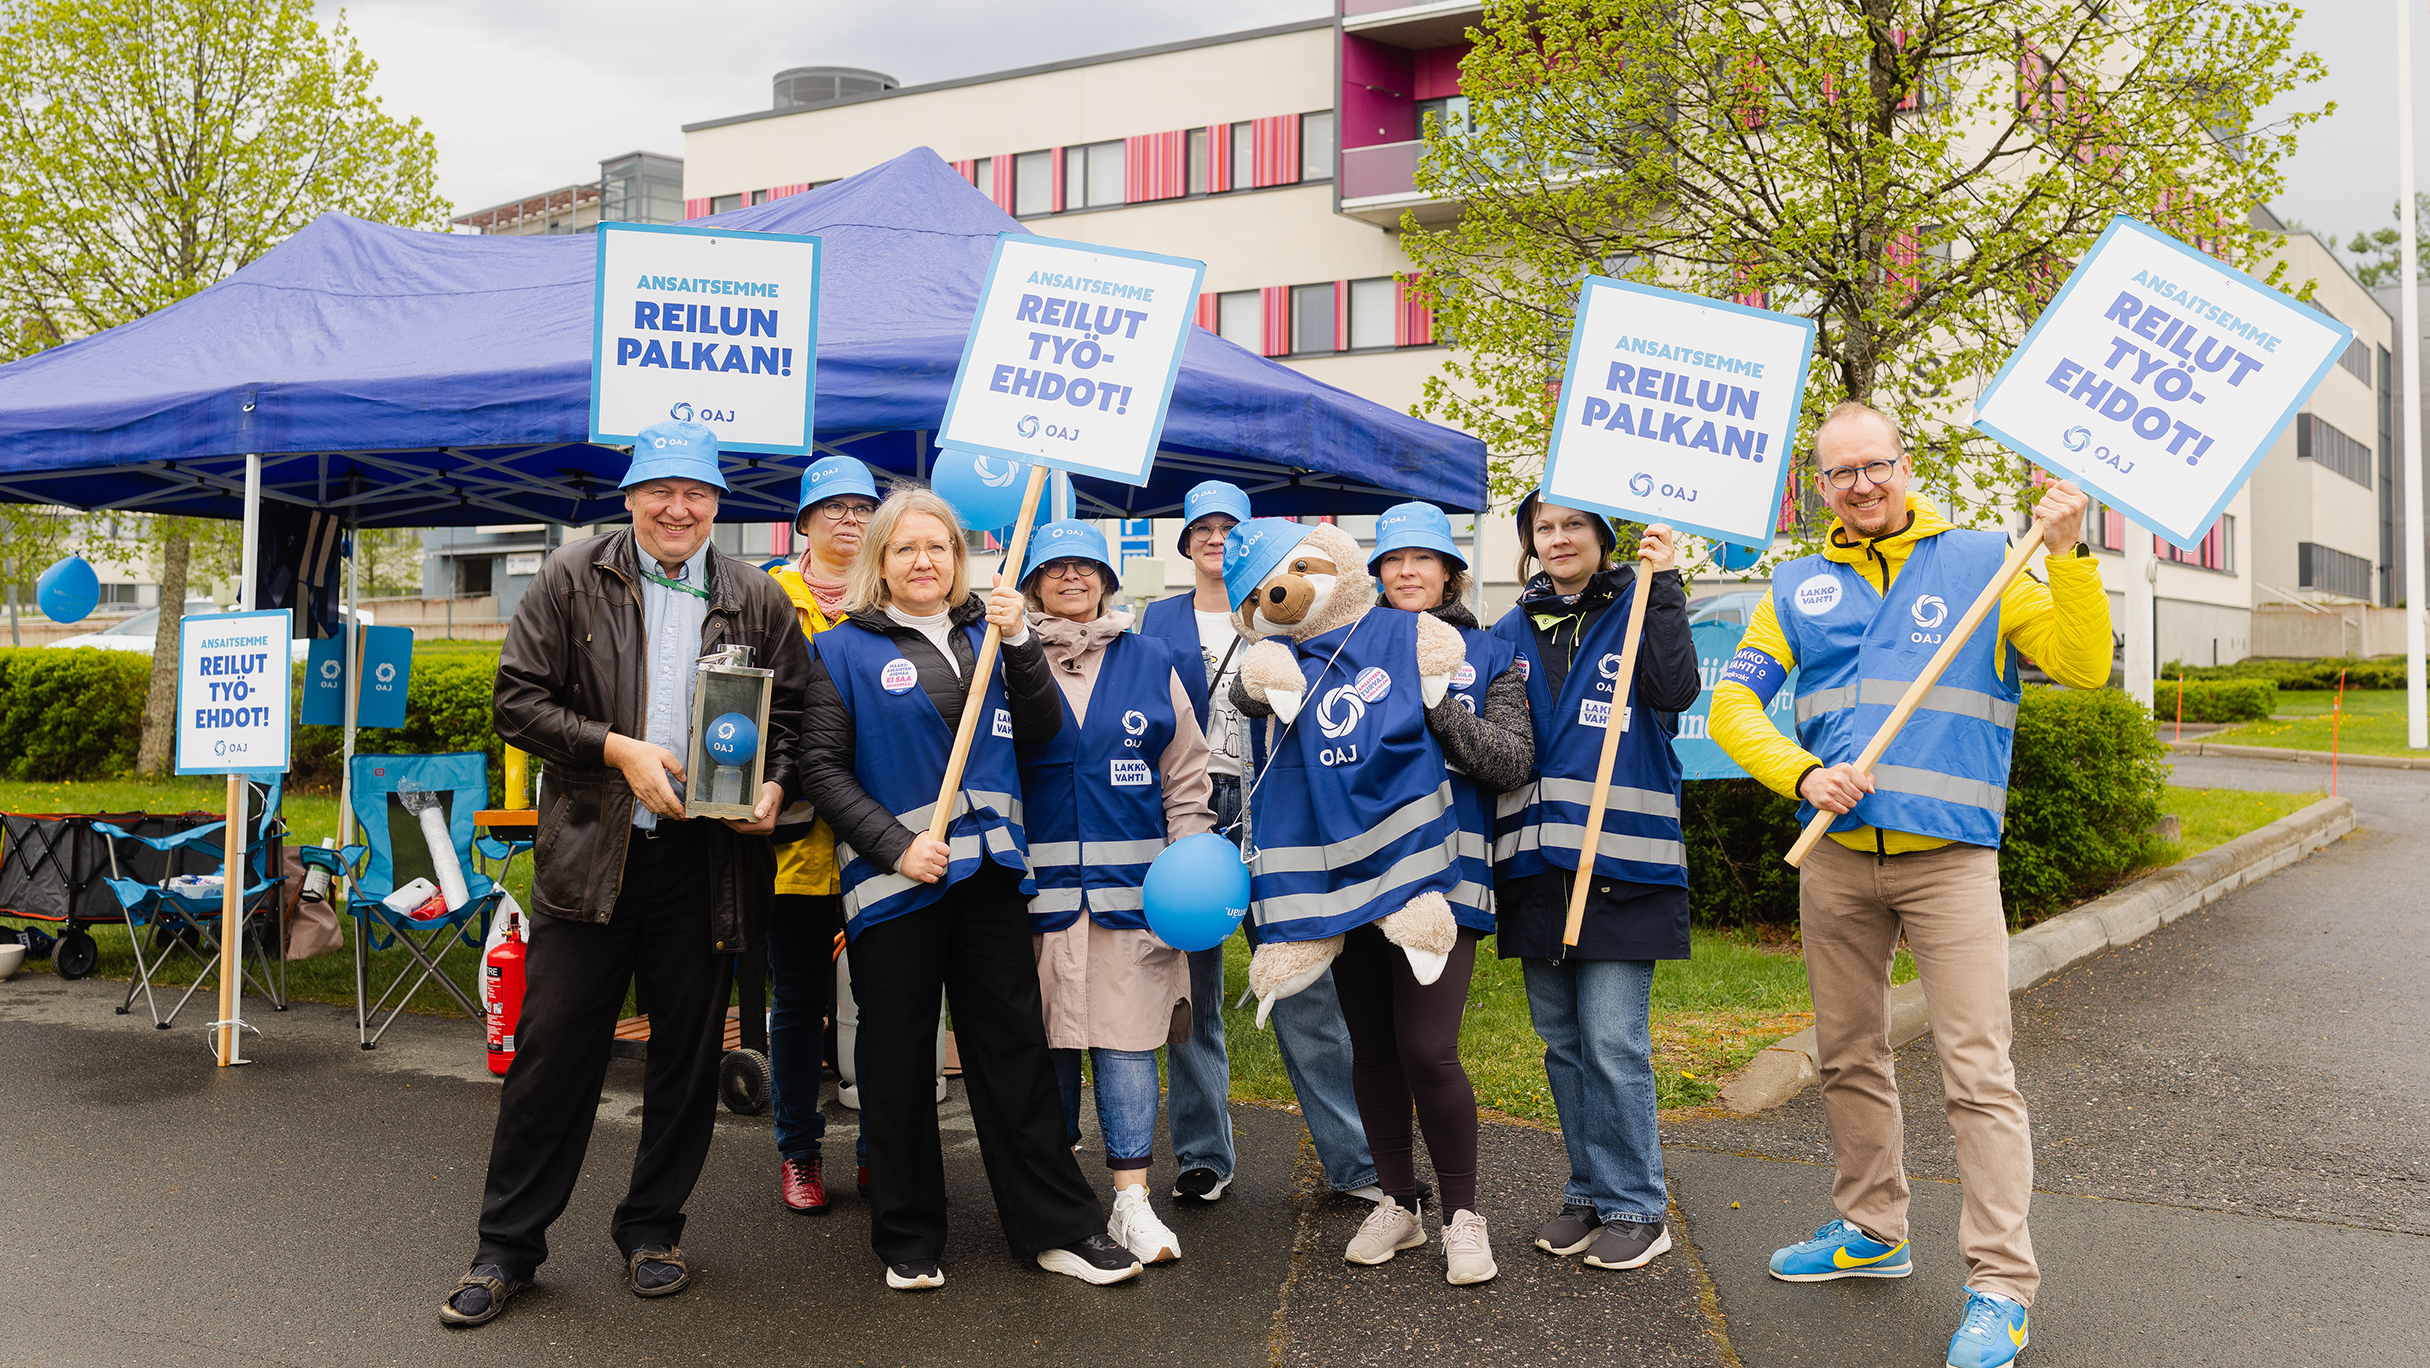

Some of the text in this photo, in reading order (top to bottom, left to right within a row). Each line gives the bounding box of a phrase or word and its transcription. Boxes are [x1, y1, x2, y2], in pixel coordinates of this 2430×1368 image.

[637, 275, 779, 298] ANSAITSEMME
[1026, 271, 1155, 303] ANSAITSEMME
[634, 300, 778, 338] REILUN
[1016, 293, 1148, 340] REILUT
[2131, 269, 2282, 354] ANSAITSEMME
[2104, 290, 2264, 387] REILUT
[617, 337, 793, 377] PALKAN!
[1029, 332, 1115, 370] TYÖ-
[1615, 335, 1765, 379] ANSAITSEMME
[2104, 336, 2206, 405] TYÖ-
[989, 363, 1133, 415] EHDOT!
[1606, 361, 1760, 421] REILUN
[700, 409, 735, 423] OAJ
[2045, 357, 2215, 466] EHDOT!
[1045, 424, 1080, 442] OAJ
[1581, 396, 1769, 463] PALKAN!
[669, 438, 688, 446] OAJ
[822, 467, 839, 476] OAJ
[2094, 446, 2135, 475] OAJ
[1200, 489, 1217, 497] OAJ
[1661, 484, 1698, 503] OAJ
[1390, 515, 1406, 524] OAJ
[1066, 529, 1084, 537] OAJ
[1248, 530, 1264, 545] OAJ
[1800, 586, 1838, 597] LAKKO-
[1802, 595, 1833, 605] VAHTI
[201, 636, 268, 649] ANSAITSEMME
[1911, 632, 1942, 644] OAJ
[200, 653, 267, 676] REILUT
[209, 675, 255, 701] TYÖ-
[1360, 673, 1386, 697] TURVAA
[1596, 682, 1615, 693] OA
[195, 707, 269, 729] EHDOT!
[997, 724, 1013, 734] VAH
[1584, 713, 1609, 724] VAH
[229, 743, 248, 752] OAJ
[714, 742, 733, 753] OAJ
[1320, 744, 1357, 766] OAJ
[1115, 774, 1144, 782] VAHTI
